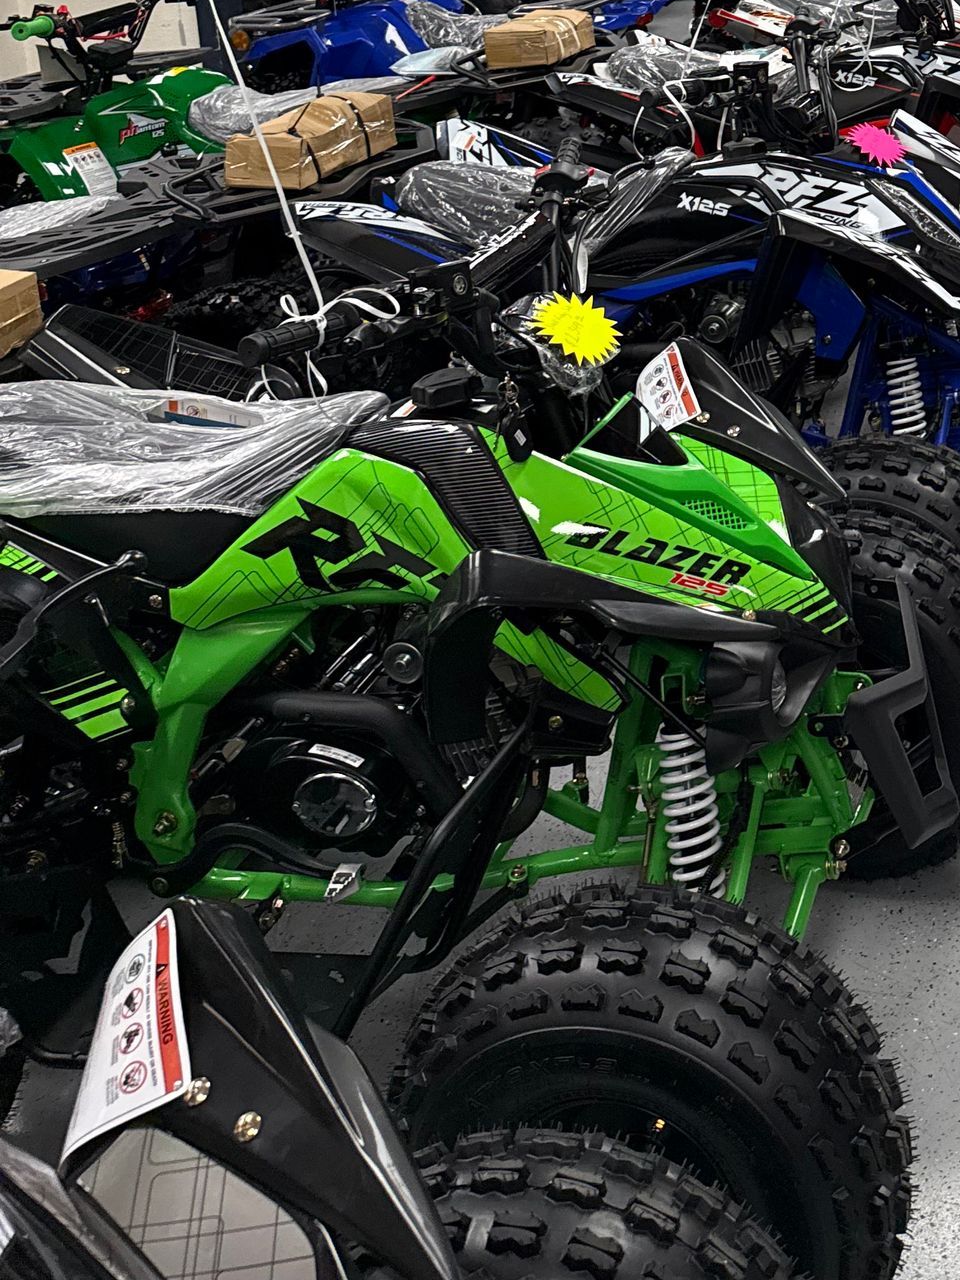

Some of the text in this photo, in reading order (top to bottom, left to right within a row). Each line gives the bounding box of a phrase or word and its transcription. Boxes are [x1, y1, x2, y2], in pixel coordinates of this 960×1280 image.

[834, 70, 879, 87] X125
[677, 191, 733, 217] X125
[761, 166, 872, 218] RFZ
[564, 522, 752, 586] BLAZER
[669, 572, 731, 597] 125
[156, 976, 174, 1046] WARNING
